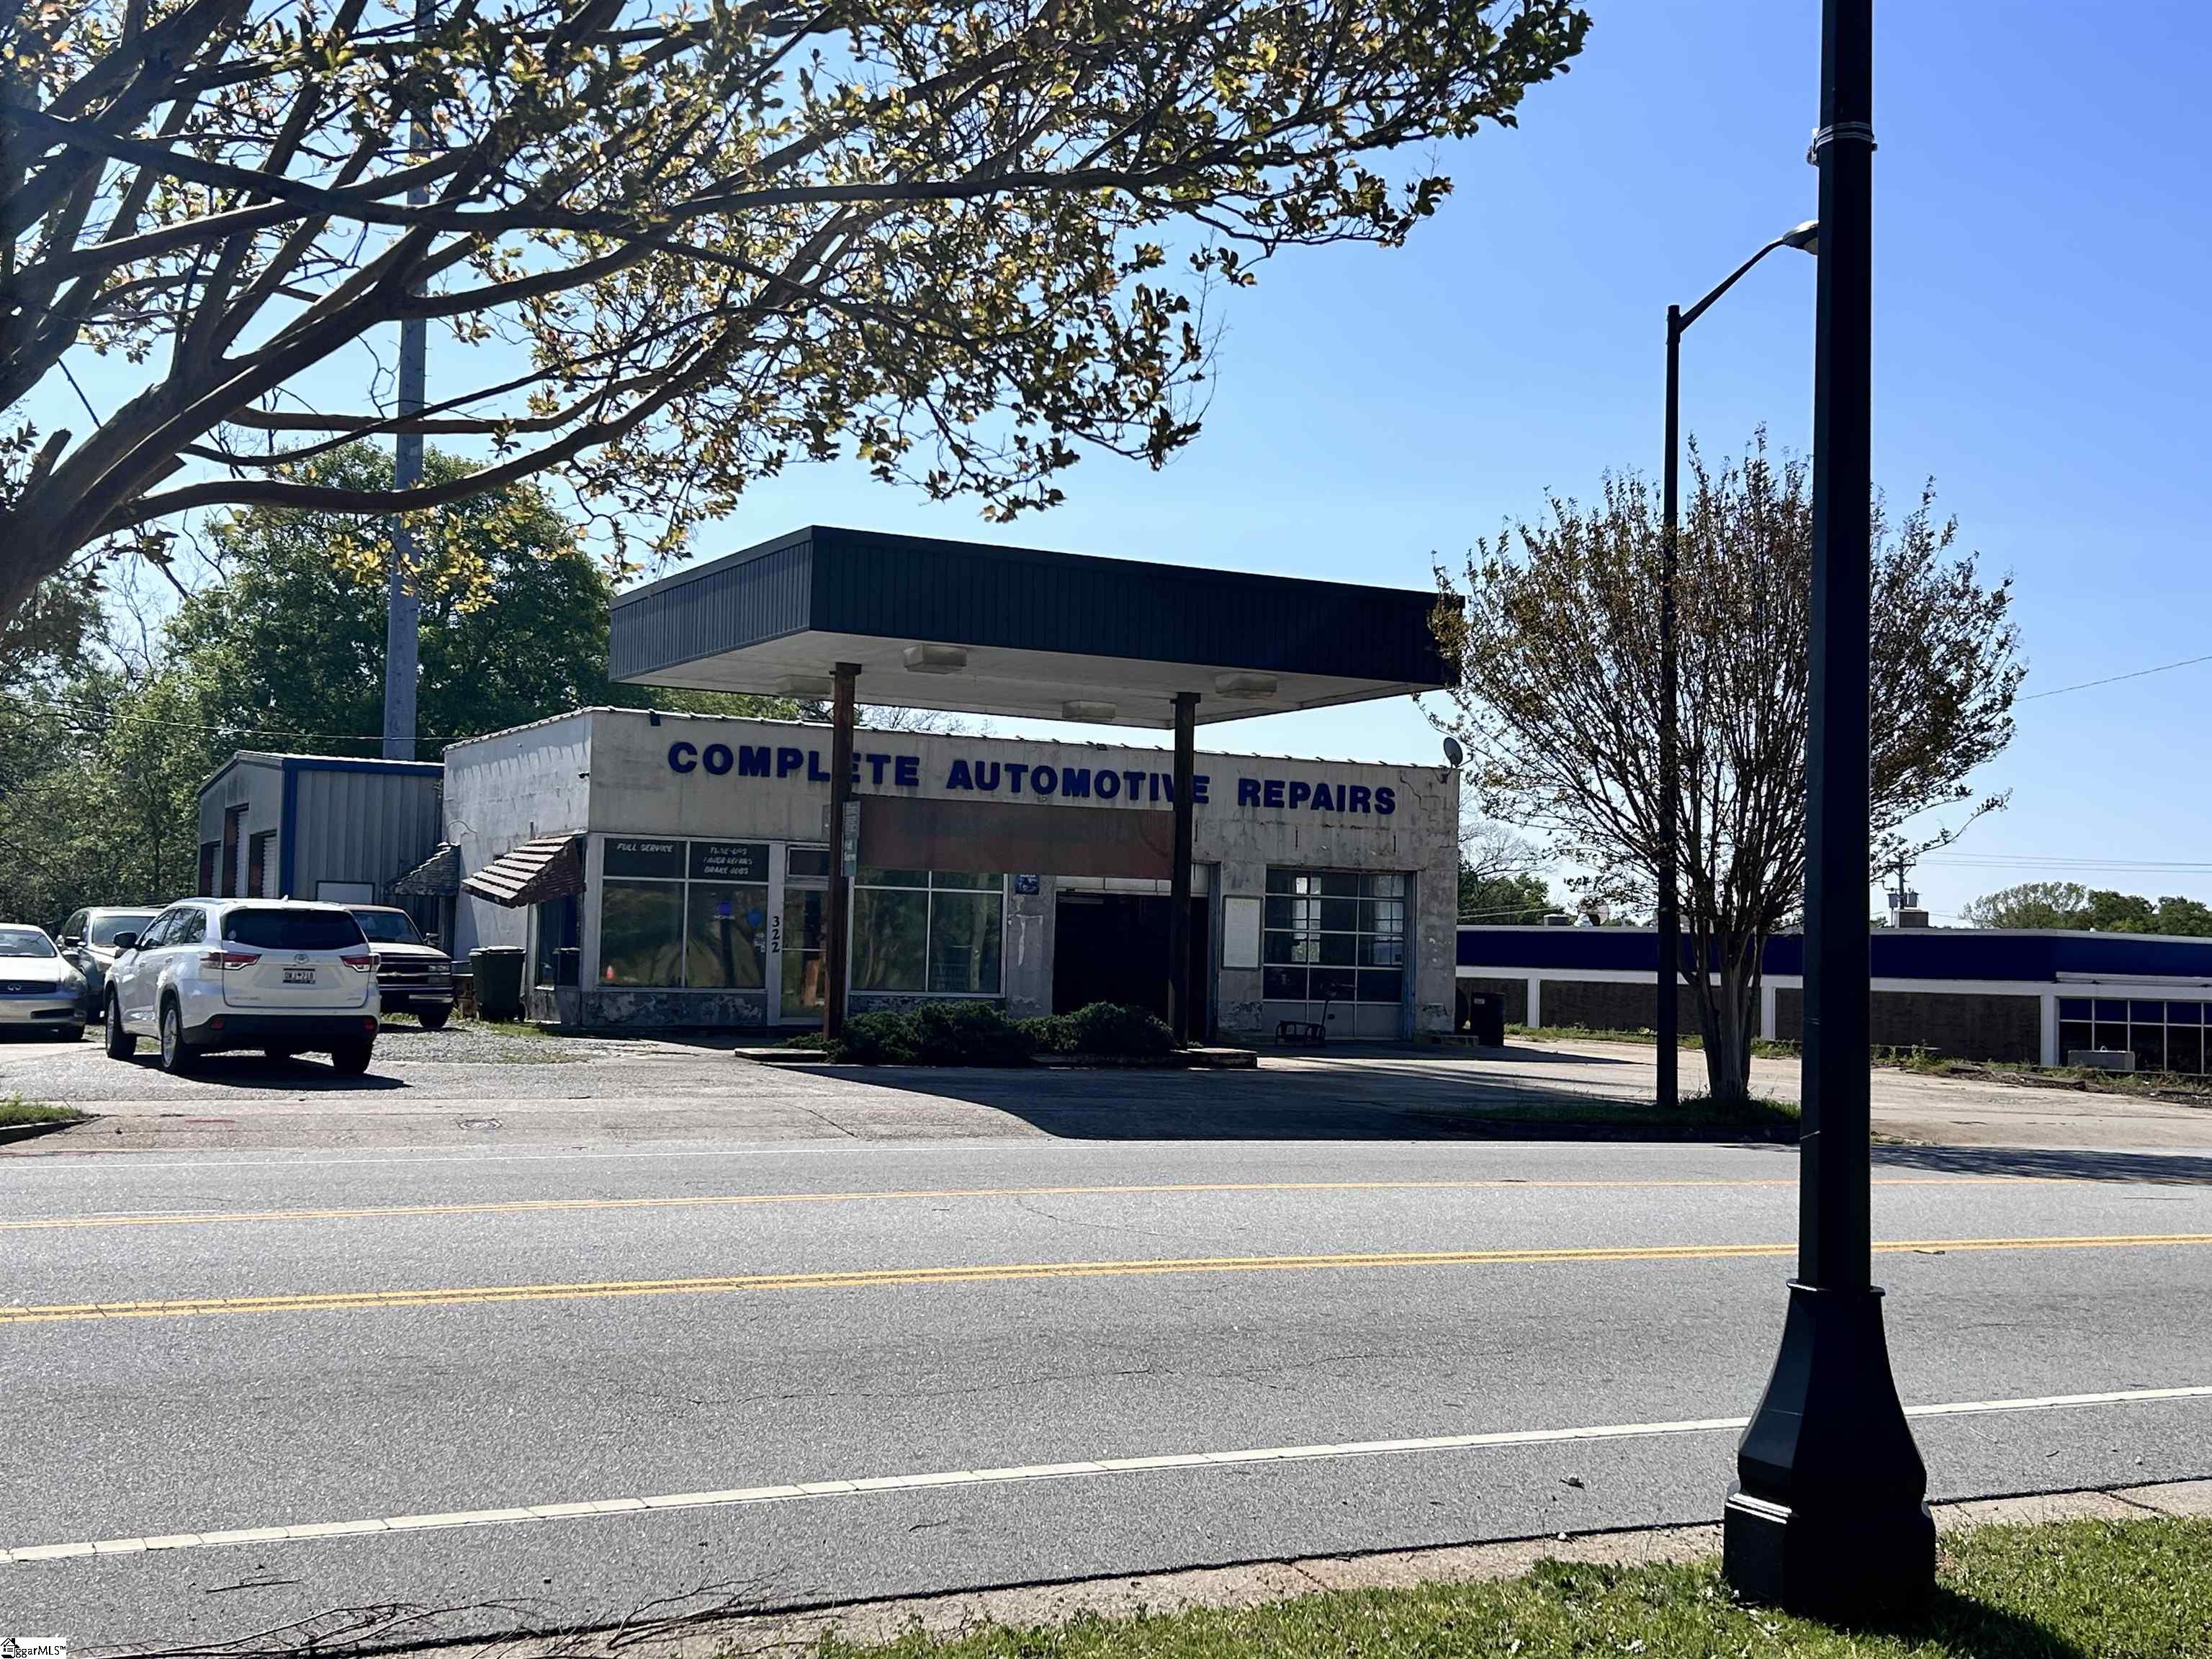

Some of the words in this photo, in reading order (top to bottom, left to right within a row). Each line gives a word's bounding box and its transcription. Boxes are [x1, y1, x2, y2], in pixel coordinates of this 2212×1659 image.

[946, 760, 1210, 804] AUTOMOTIVE
[1238, 778, 1395, 814] REPAIRS
[616, 842, 637, 852] FULL
[771, 915, 781, 953] 322
